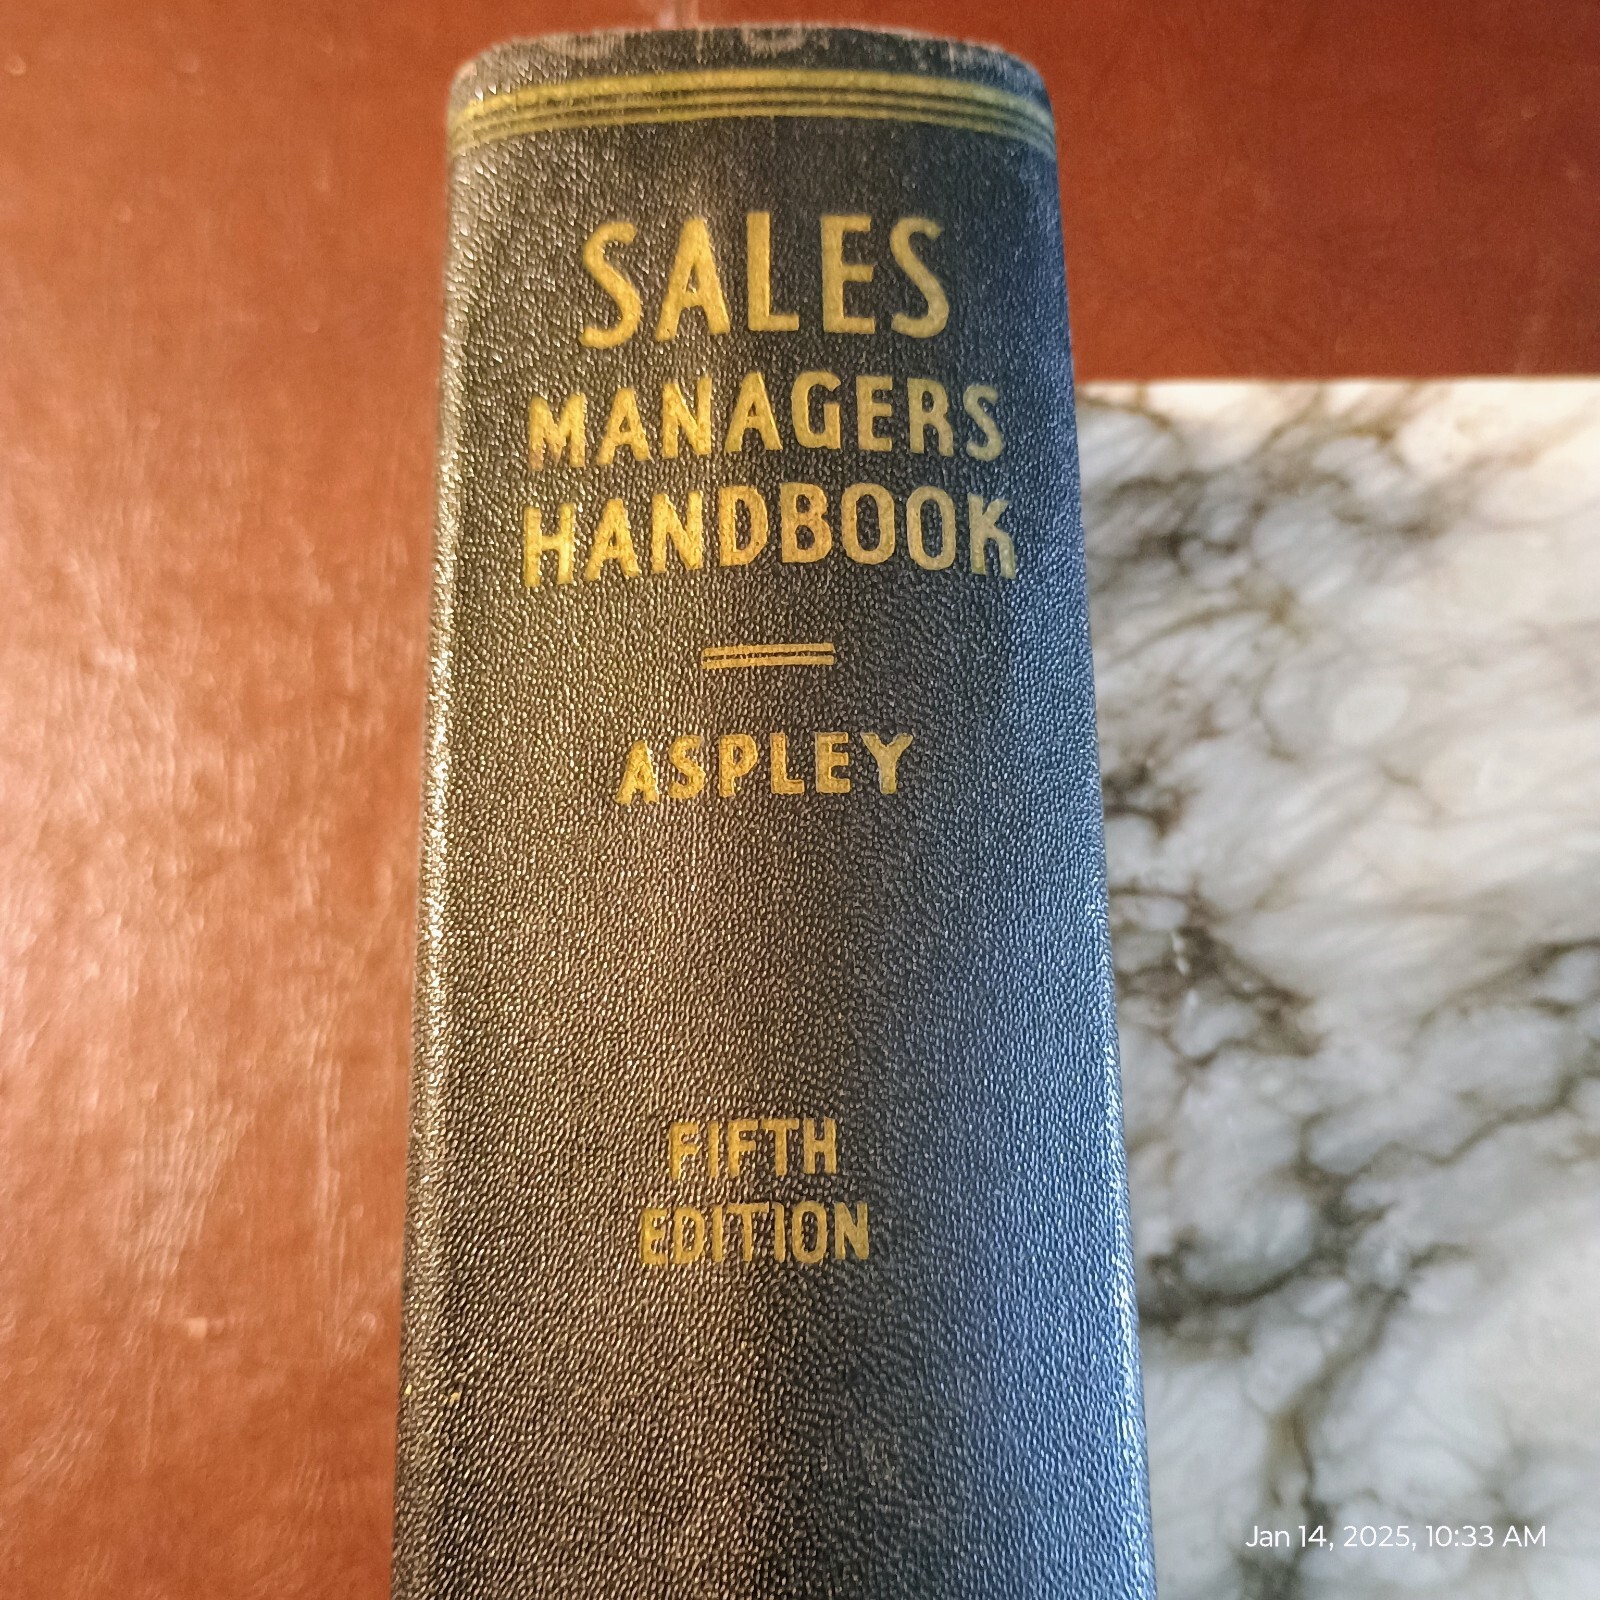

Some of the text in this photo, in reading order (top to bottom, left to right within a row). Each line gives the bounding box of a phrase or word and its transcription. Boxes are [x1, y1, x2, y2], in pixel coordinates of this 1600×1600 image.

[580, 211, 951, 349] SALES
[526, 371, 1005, 472] MANAGERS
[523, 484, 1017, 589] HANDBOOK
[617, 732, 914, 806] ASPLEY
[668, 1117, 838, 1181] FIFTH
[640, 1201, 870, 1266] EDITION
